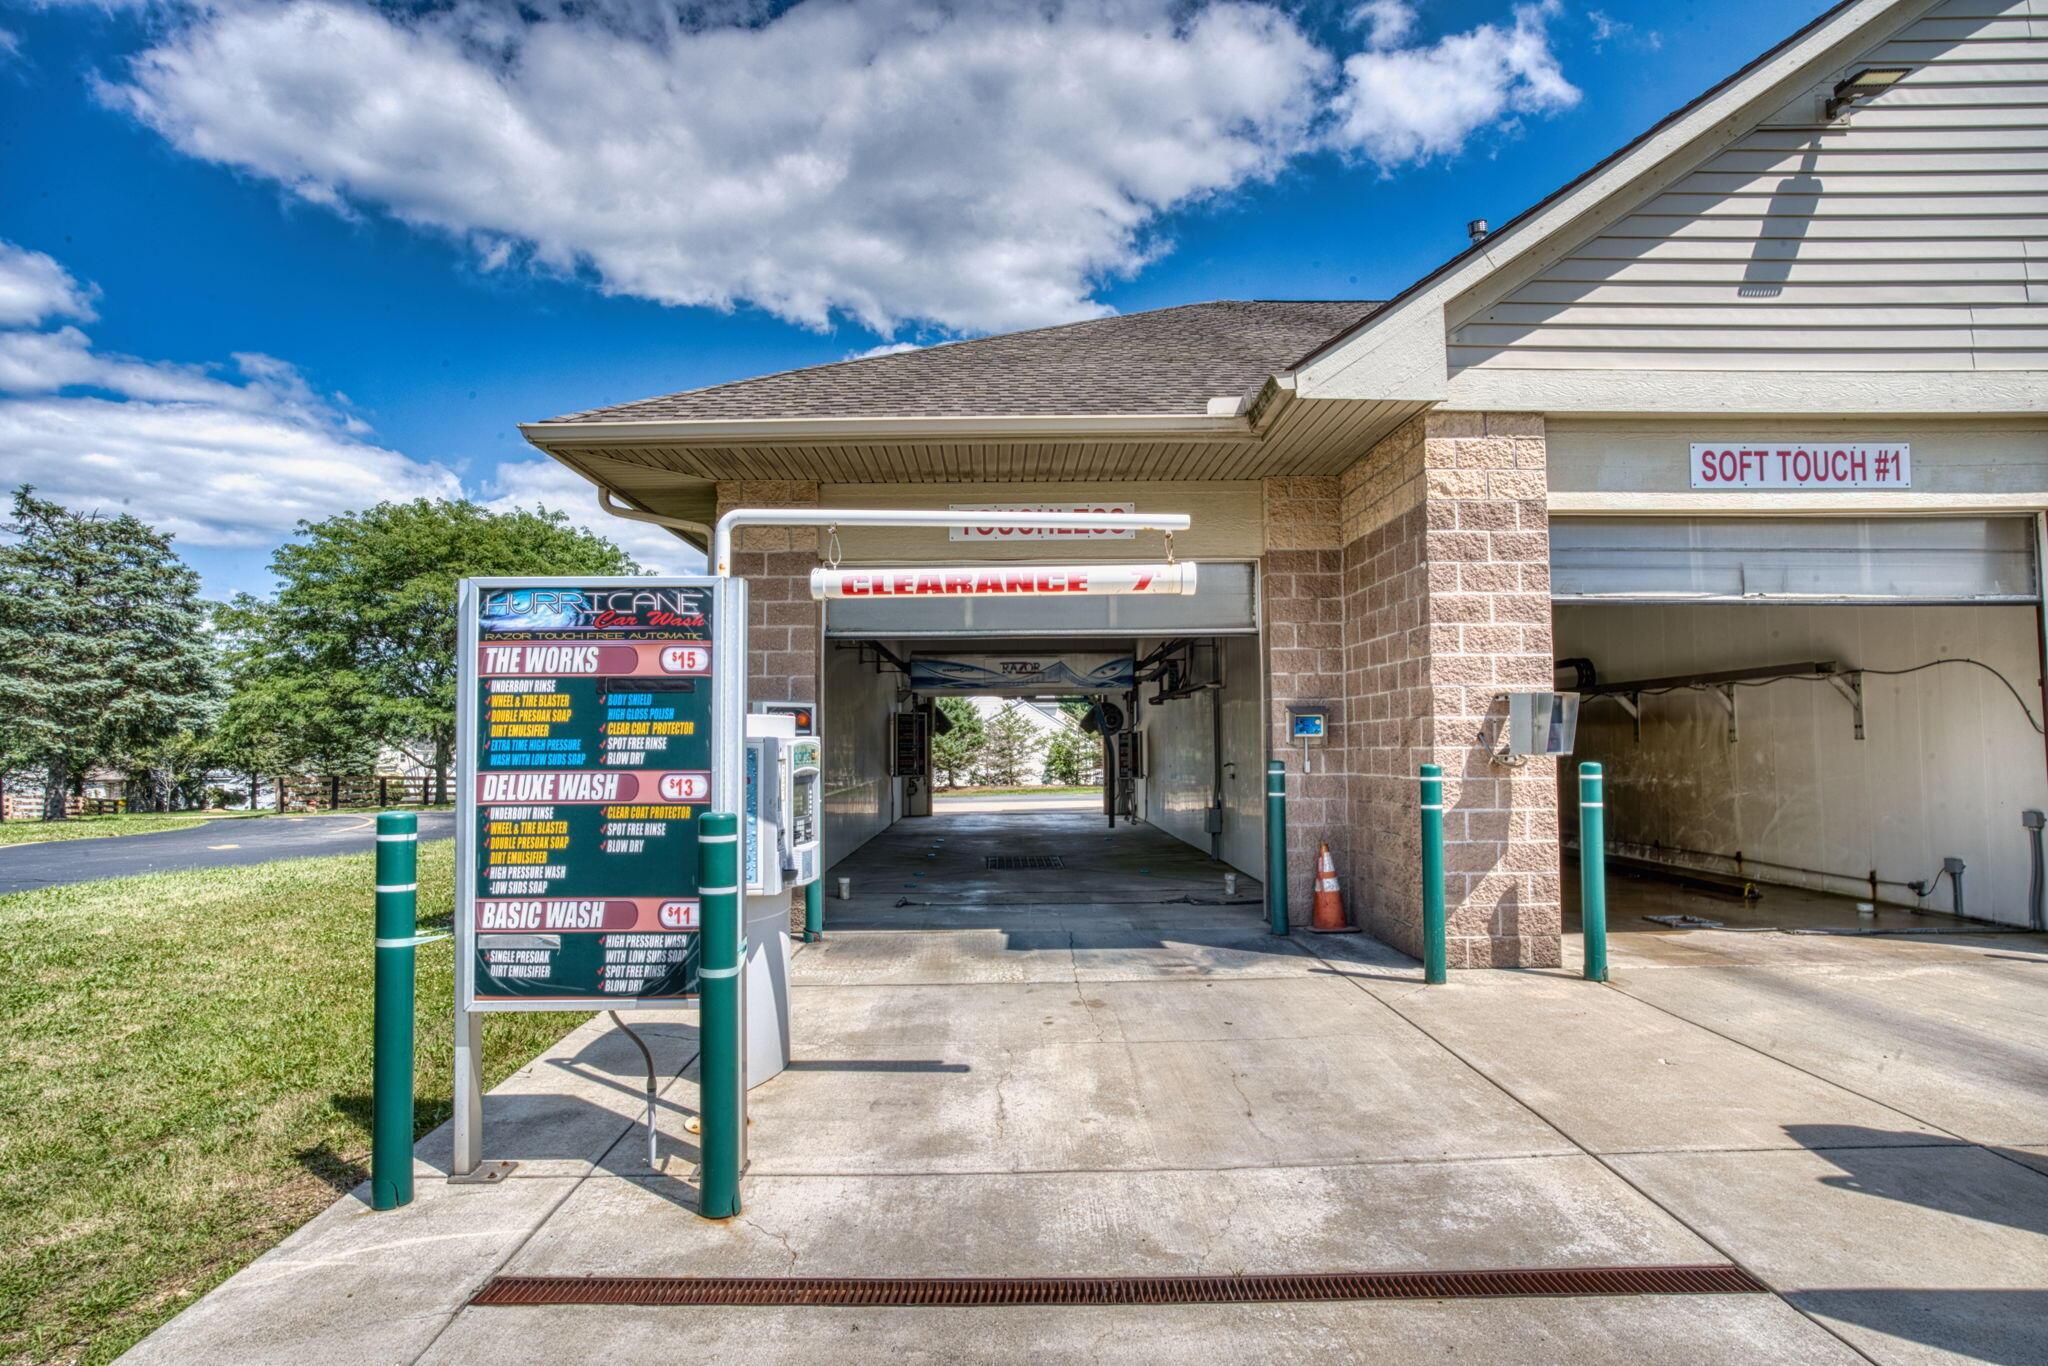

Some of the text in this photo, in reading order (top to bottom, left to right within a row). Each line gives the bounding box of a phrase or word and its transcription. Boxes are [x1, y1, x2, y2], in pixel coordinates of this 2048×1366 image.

[1701, 450, 1902, 482] SOFT TOUCH #1
[841, 572, 1088, 596] CLEARANCE
[485, 591, 704, 615] HURRICANE
[593, 610, 705, 629] Car Wash
[629, 632, 704, 640] AUTOMATIC
[485, 646, 600, 674] THE WORKS
[672, 651, 697, 669] $15
[1000, 662, 1041, 675] RAZOR
[491, 679, 556, 693] UNDERBODY RINSE
[491, 694, 570, 708] WHEEL & TIRE BLASTER
[608, 693, 652, 706] BODY SHIELD
[491, 709, 572, 723] DOUBLE PRESOAK SOAP
[608, 707, 675, 720] HIGH GLOSS POLISH
[491, 724, 549, 738] DIRT EMULSIFIER
[608, 721, 694, 735] CLEAR COAT PROTECTOR
[491, 739, 581, 752] EXTRA TIME HIGH PRESSURE
[607, 737, 667, 750] SPOT FREE RINSE
[490, 754, 586, 767] WASH WITH LOW SUDS SOAP
[607, 752, 646, 765] BLOW DRY
[482, 773, 619, 802] DELUXE WASH
[670, 778, 693, 797] $13
[490, 806, 554, 820] UNDERBODY RINSE
[607, 806, 691, 819] CLEAR COAT PROTECTOR
[490, 821, 568, 835] WHEEL & TIRE BLASTER
[607, 823, 666, 836] SPOT FREE RINSE
[490, 836, 570, 850] DOUBLE PRESOAK SOAP
[606, 839, 644, 853] BLOW DRY
[490, 851, 548, 865] DIRT EMULSIFIER
[489, 866, 567, 880] HIGH PRESSURE WASH
[507, 881, 528, 895] SUDS
[527, 881, 548, 894] SOAP
[481, 901, 606, 929] BASIC WASH
[668, 906, 691, 924] $11
[605, 934, 688, 948] HIGH PRESSURE WASH
[490, 950, 550, 964] SINGLE PRESOAK
[605, 950, 688, 963] WITH LOW SUDS SOAP
[490, 964, 551, 978] DIRT EMULSIFIER
[604, 965, 666, 978] SPOT FREE RINSE
[604, 980, 645, 993] BLOW DRY
